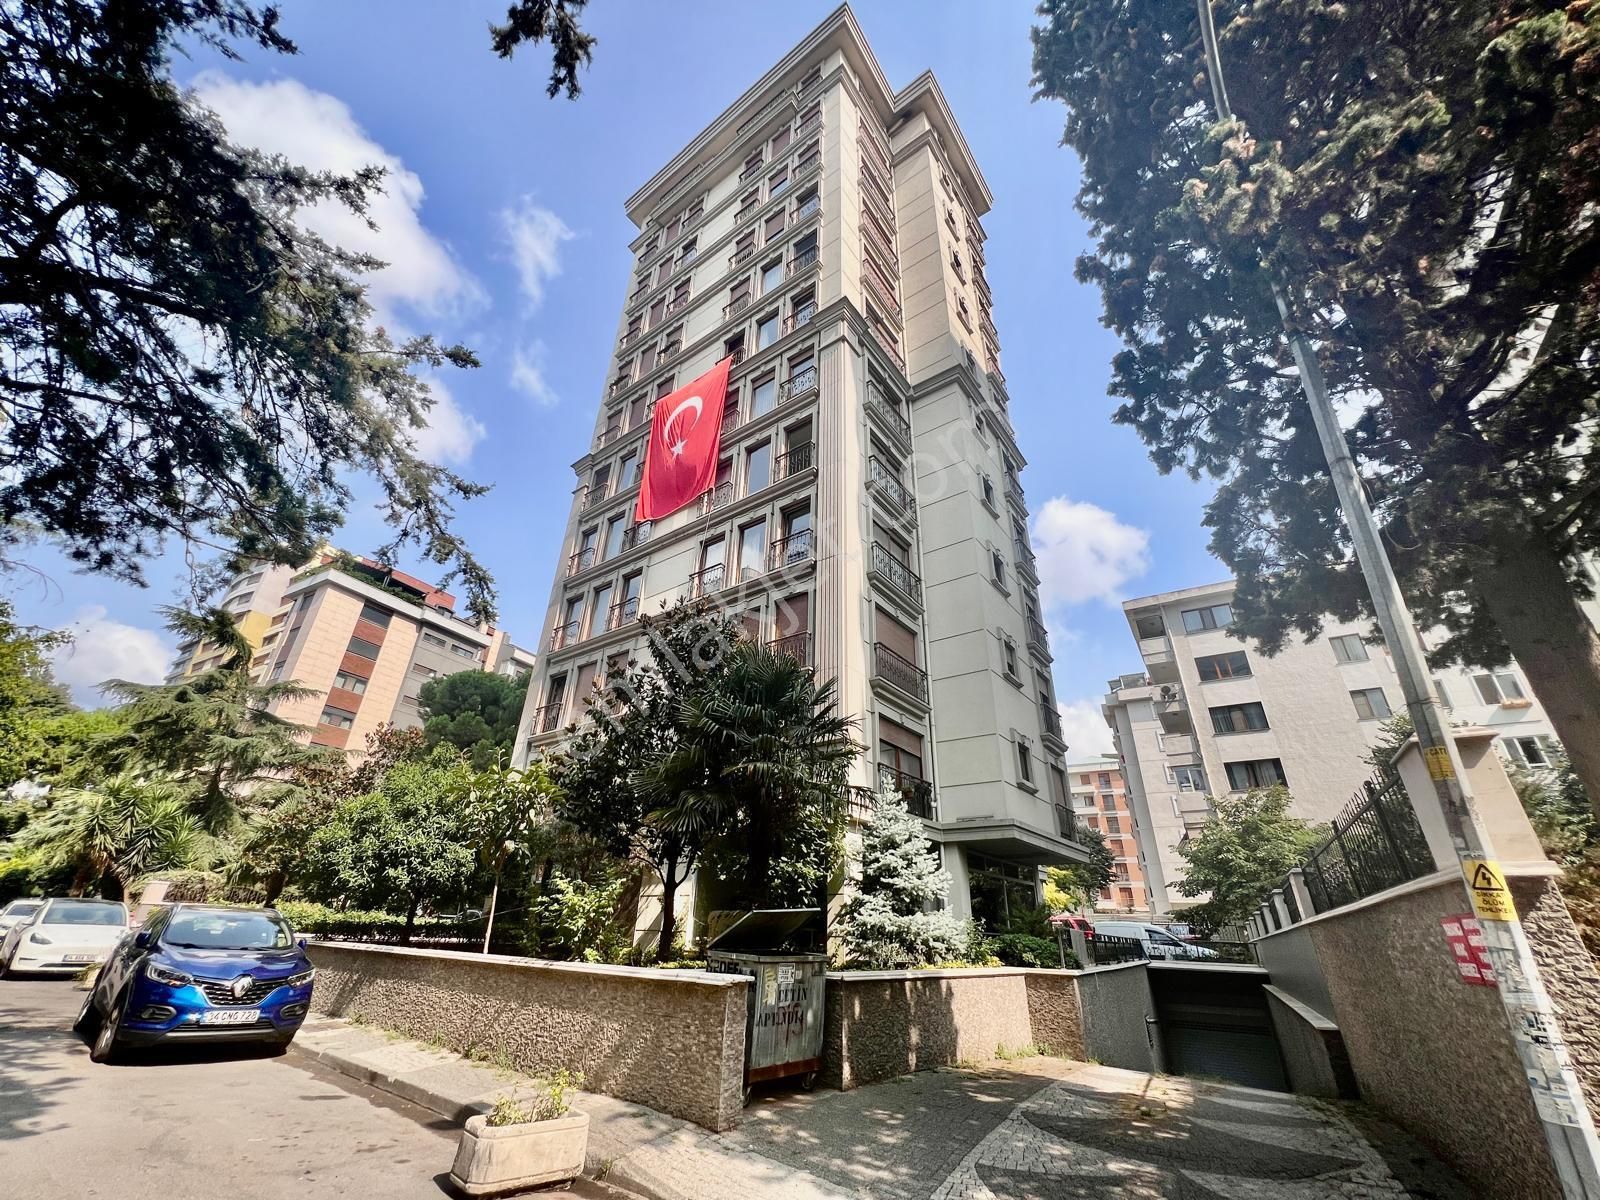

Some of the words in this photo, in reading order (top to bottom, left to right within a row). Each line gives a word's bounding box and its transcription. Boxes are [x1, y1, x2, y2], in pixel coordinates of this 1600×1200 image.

[208, 1012, 219, 1021] 34
[221, 1011, 239, 1021] CNG
[240, 1011, 257, 1021] 728
